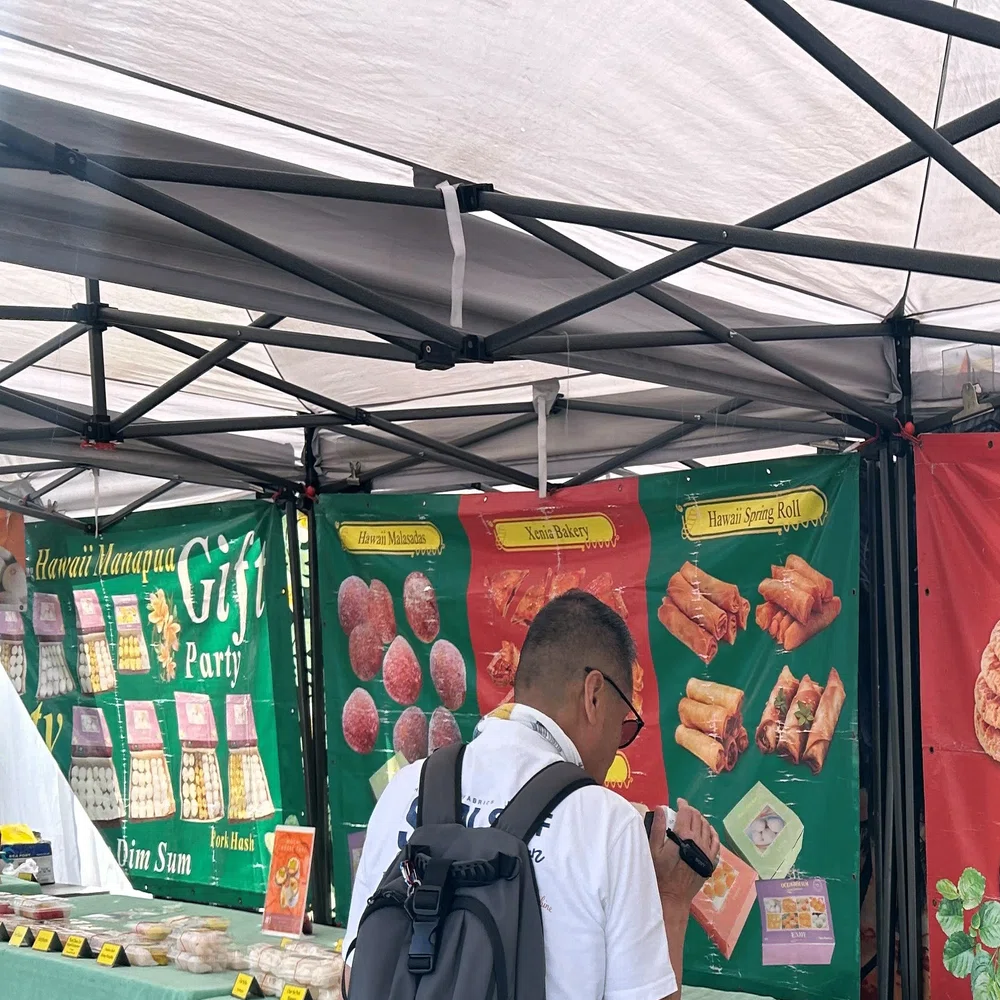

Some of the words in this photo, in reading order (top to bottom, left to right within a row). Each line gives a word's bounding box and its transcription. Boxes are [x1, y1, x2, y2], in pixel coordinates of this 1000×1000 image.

[708, 507, 742, 529] Hawaii
[744, 505, 774, 527] Spring
[777, 499, 801, 519] Roll
[357, 531, 387, 546] Hawaii
[388, 530, 427, 546] Malasadas
[524, 525, 554, 541] Xenia
[556, 524, 590, 541] Bakery
[36, 544, 93, 581] Hawaii
[93, 543, 176, 584] Manapua
[177, 530, 267, 647] Gift
[185, 640, 242, 688] Party
[117, 837, 150, 870] Dim
[154, 841, 191, 876] Sum
[210, 828, 229, 850] Pork
[230, 831, 254, 852] Hash
